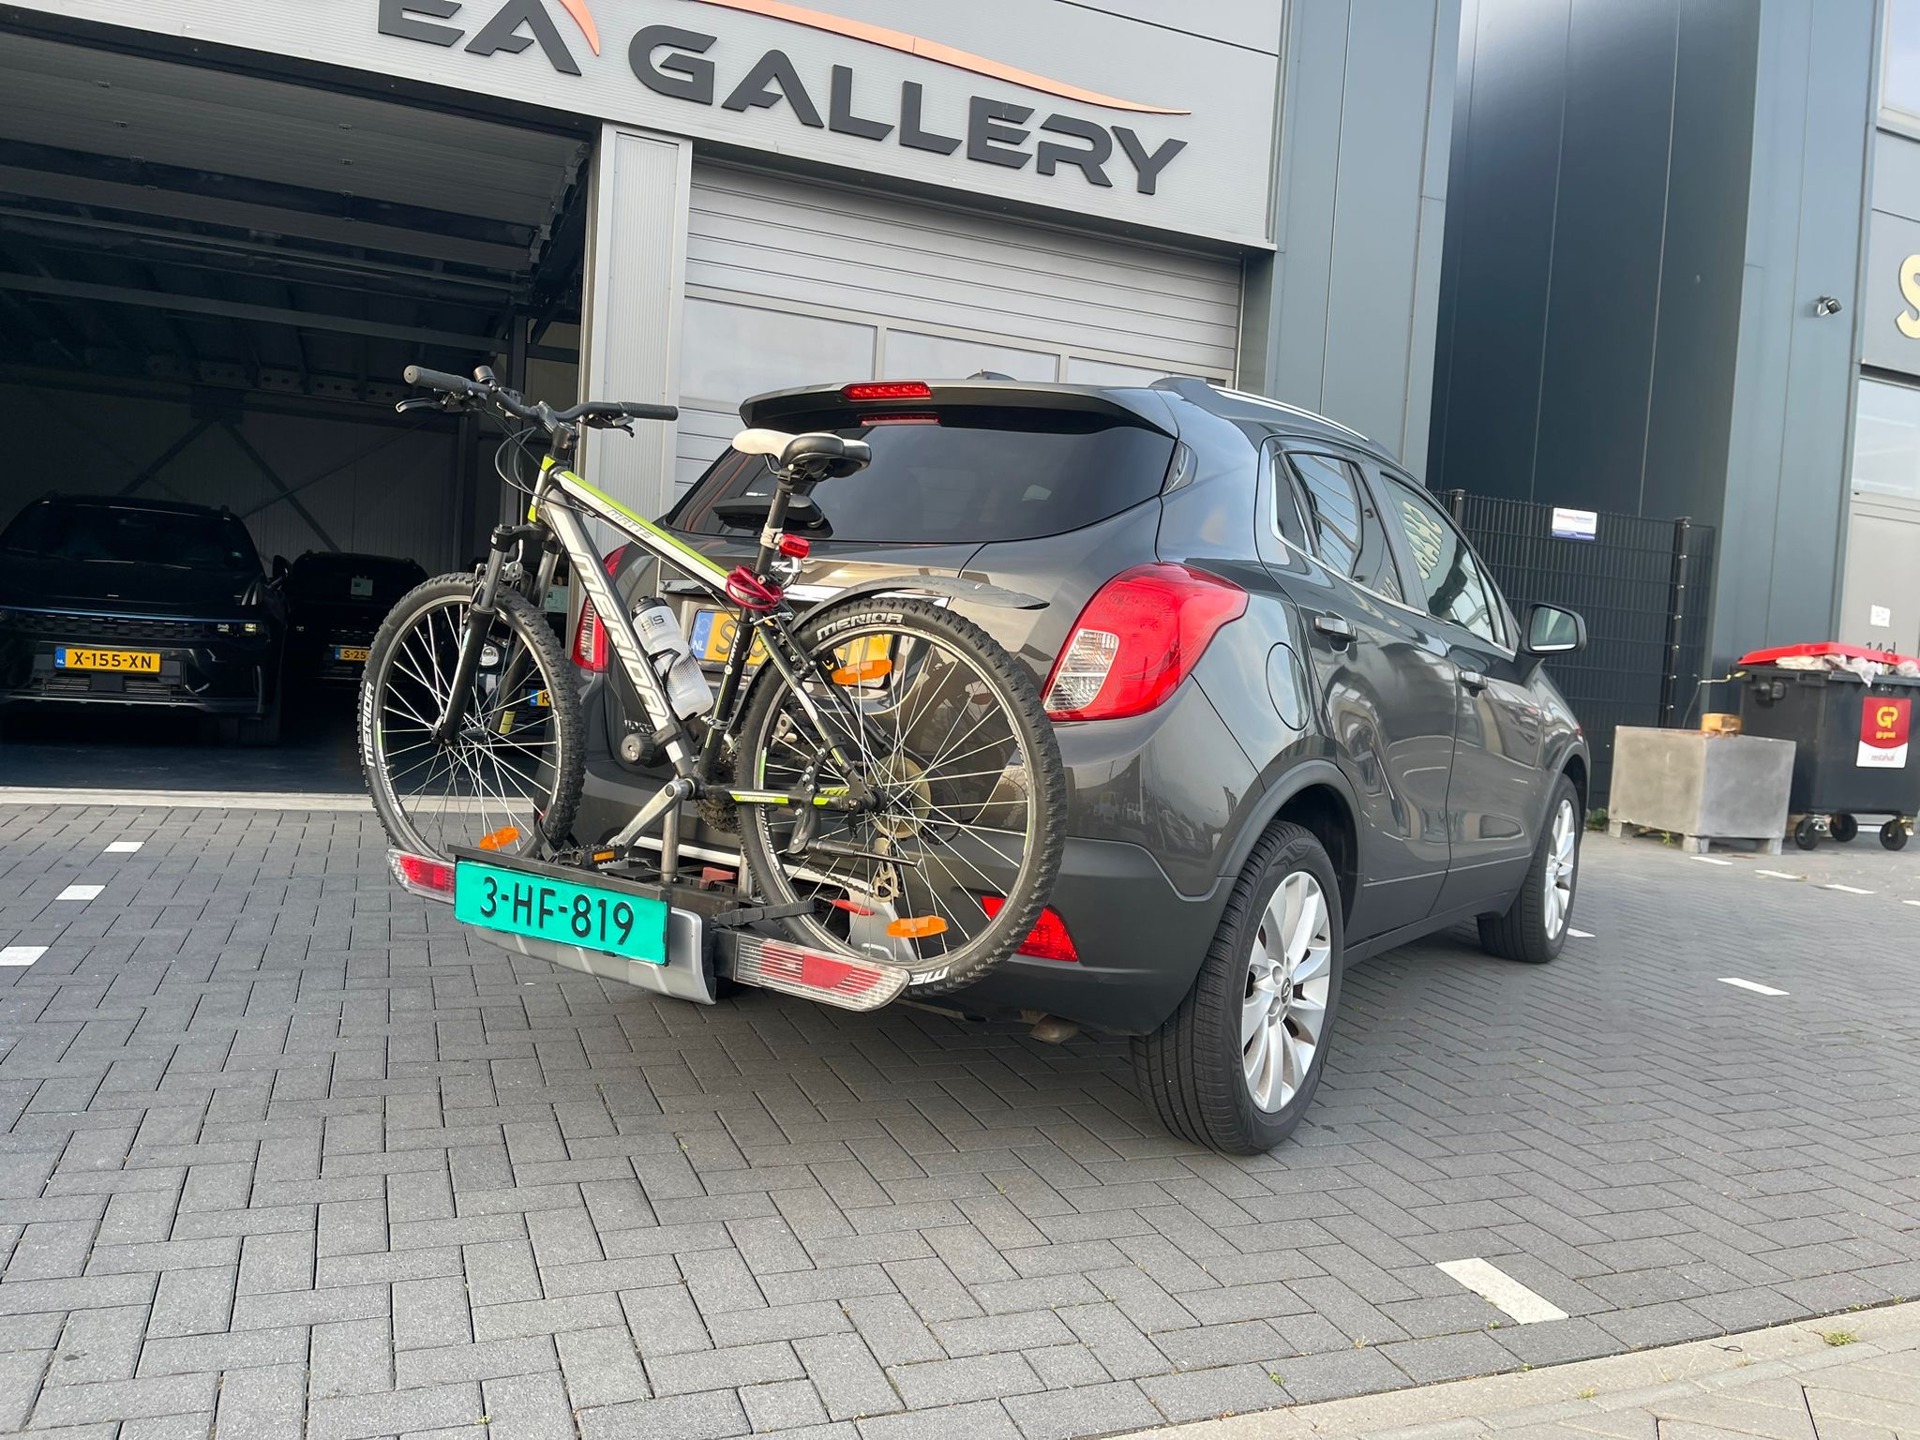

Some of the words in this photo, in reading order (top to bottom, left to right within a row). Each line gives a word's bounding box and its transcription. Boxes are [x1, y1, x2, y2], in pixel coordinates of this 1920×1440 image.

[628, 24, 1188, 195] GALLERY
[74, 651, 152, 669] X-155-XN
[344, 650, 369, 660] S-25
[570, 553, 670, 718] MERIDA
[816, 612, 904, 641] MERIDA
[362, 681, 376, 768] MERIDA
[479, 875, 635, 946] 3-HF-819
